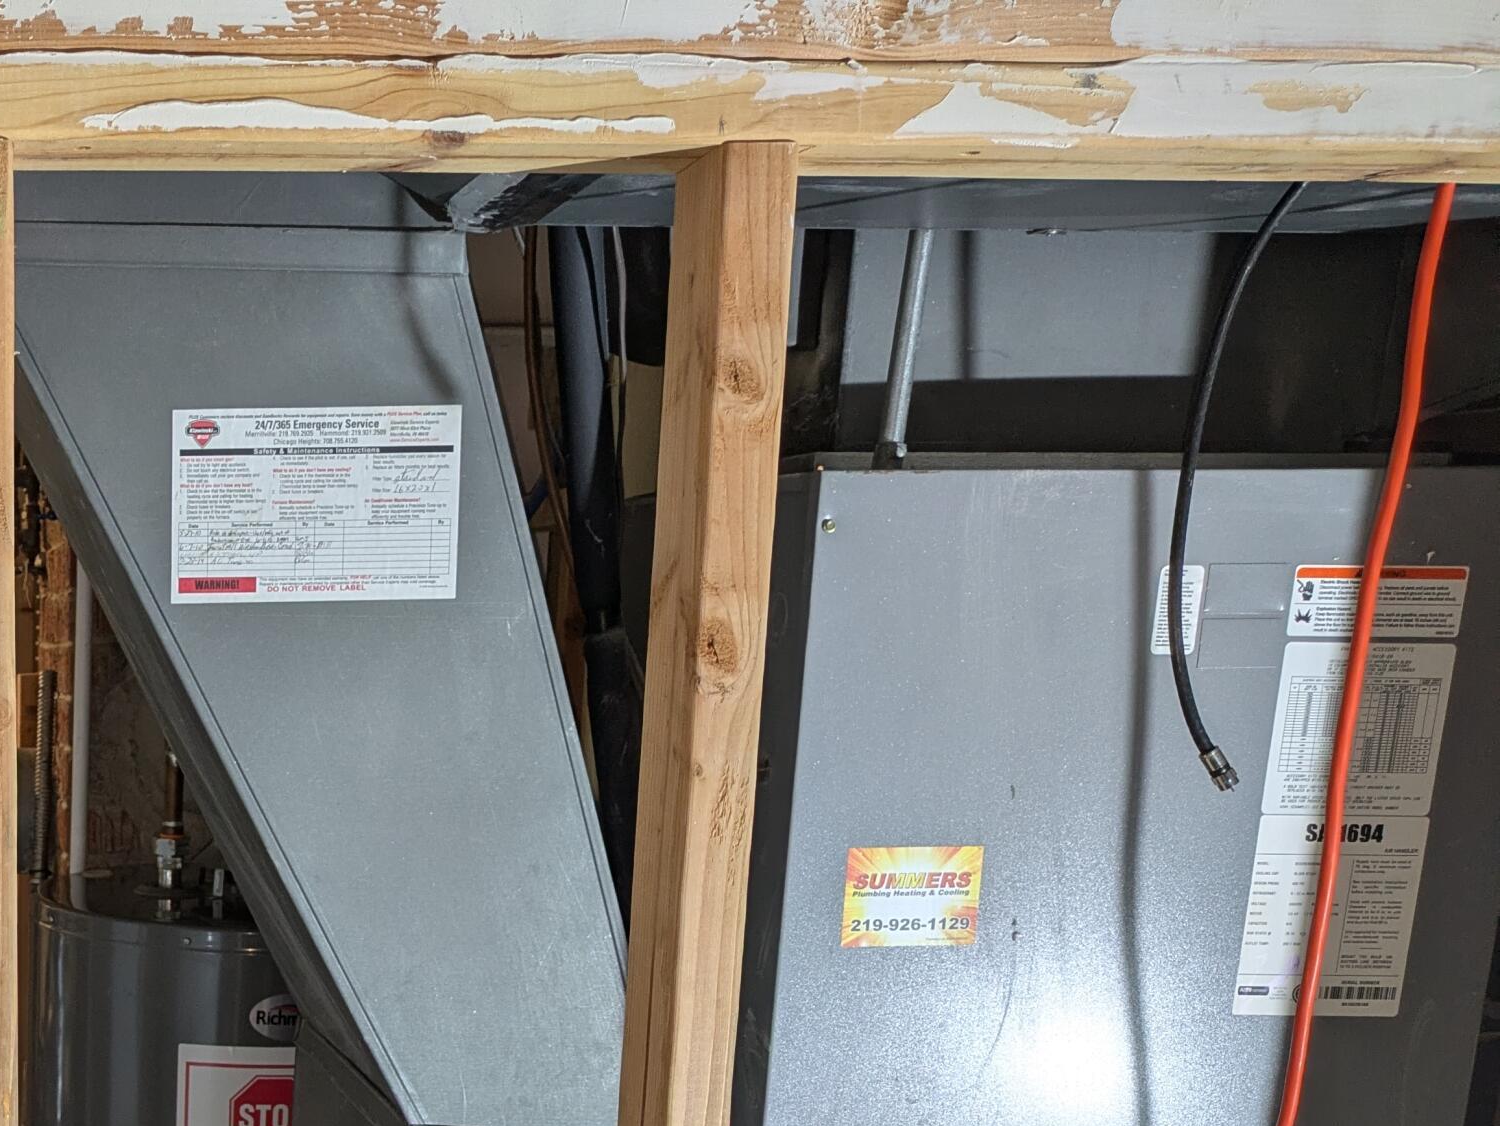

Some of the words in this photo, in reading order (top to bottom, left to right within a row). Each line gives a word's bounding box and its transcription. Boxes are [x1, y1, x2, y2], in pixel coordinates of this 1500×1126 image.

[255, 420, 291, 430] 24/7/365
[293, 419, 342, 430] Emergency
[345, 418, 380, 429] Service
[273, 438, 297, 446] Chicago
[253, 448, 277, 456] Safety
[287, 447, 333, 455] Maintenance
[336, 446, 381, 454] Instructions
[195, 580, 240, 590] WARNING!
[852, 871, 973, 890] SUMMERS
[852, 890, 891, 898] Plumbing
[938, 889, 970, 897] Cooling
[851, 917, 970, 932] 219-926-1129
